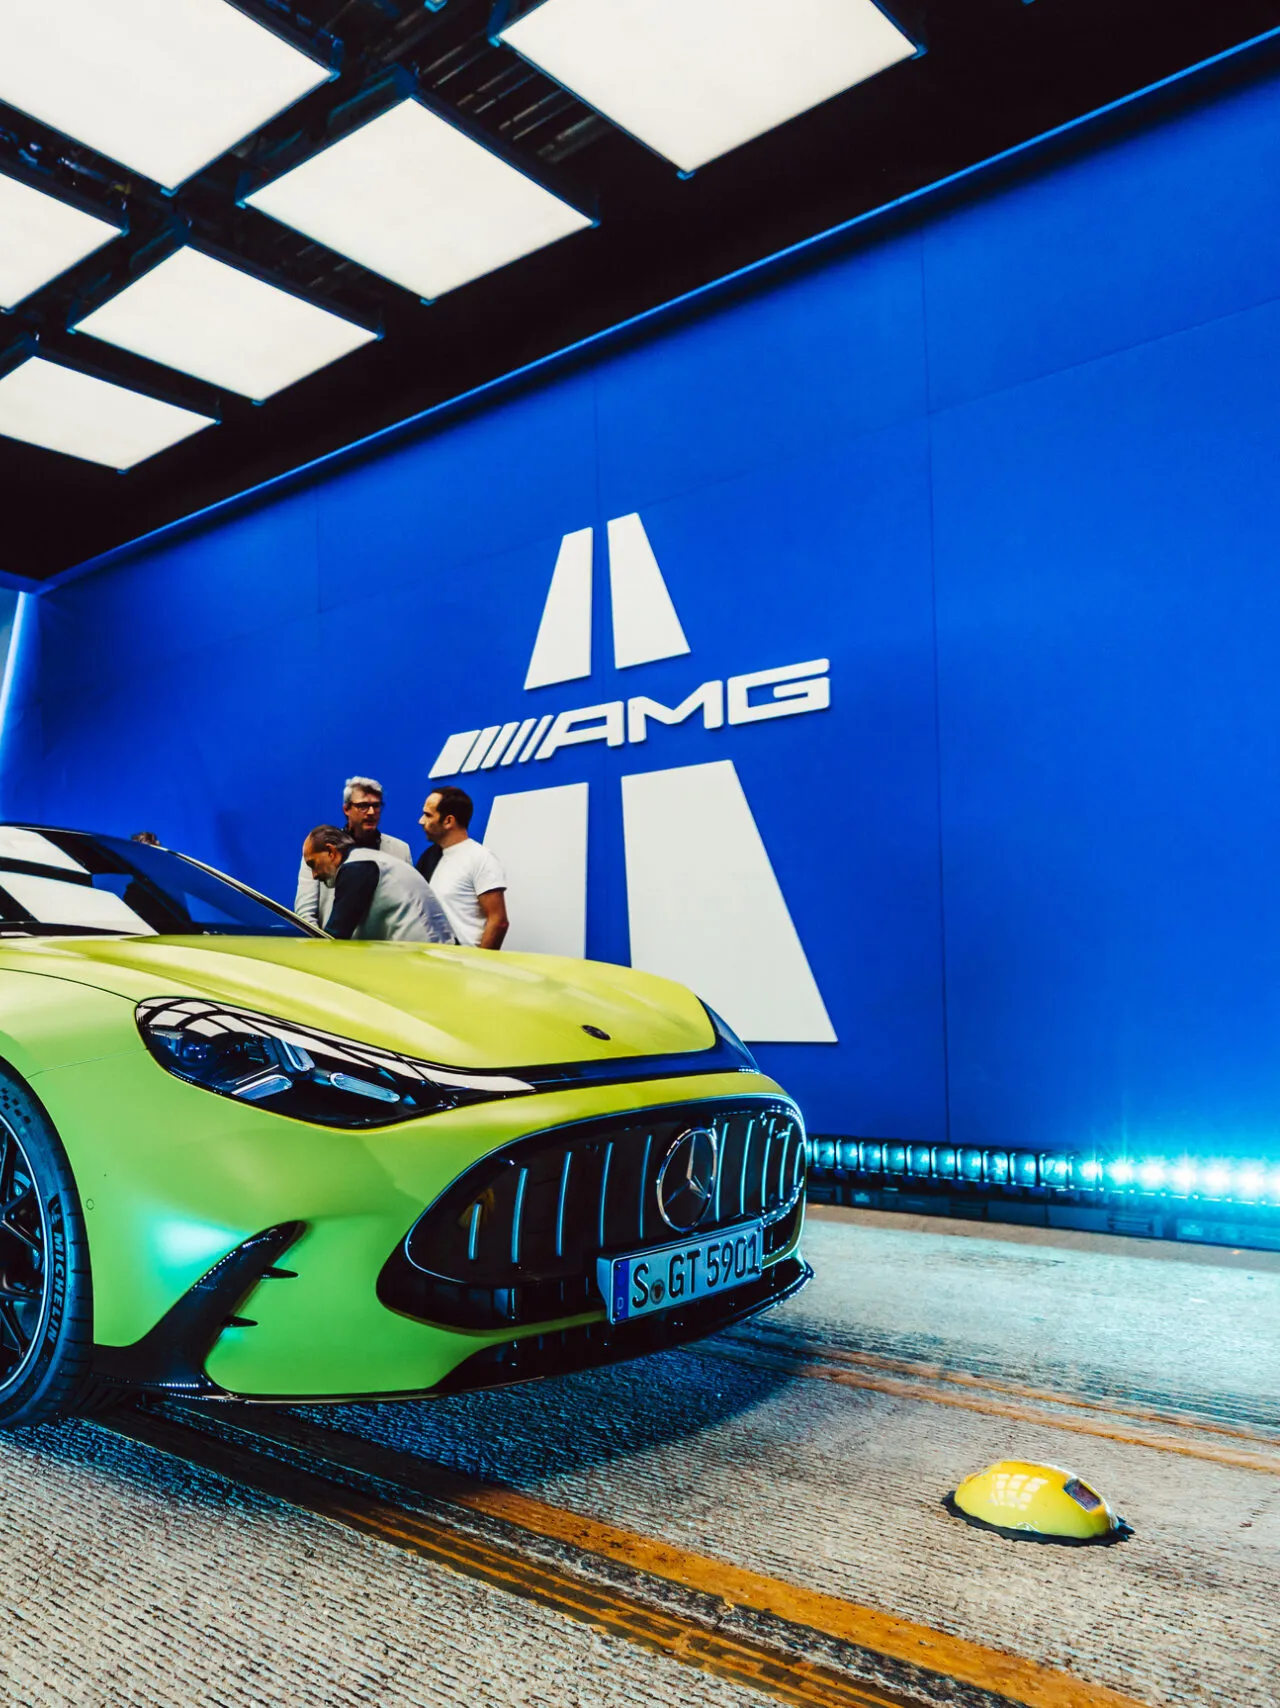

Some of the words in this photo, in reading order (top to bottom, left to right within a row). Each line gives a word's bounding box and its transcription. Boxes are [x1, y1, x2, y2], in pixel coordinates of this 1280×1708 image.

[534, 658, 830, 761] AMG
[46, 1232, 65, 1345] MICHELIN
[632, 1263, 649, 1308] S
[668, 1250, 701, 1298] GT
[706, 1234, 761, 1288] 5901
